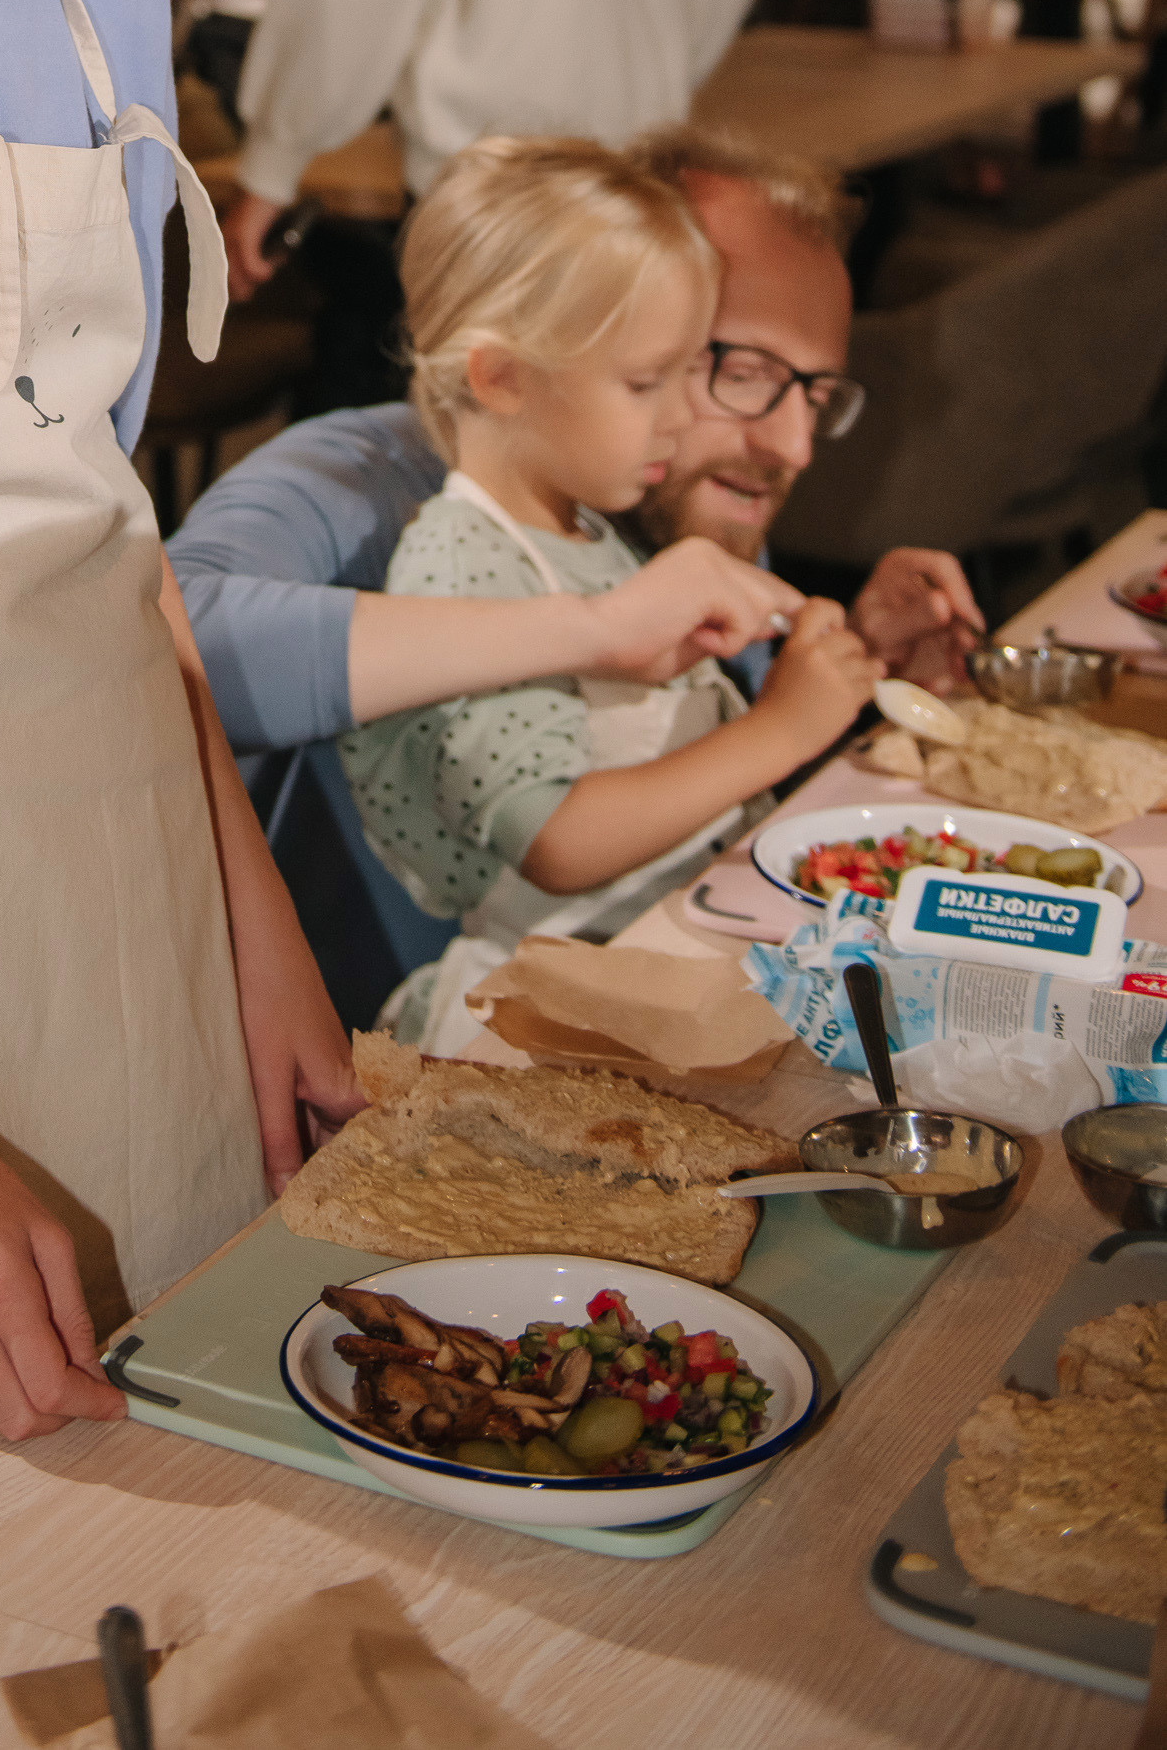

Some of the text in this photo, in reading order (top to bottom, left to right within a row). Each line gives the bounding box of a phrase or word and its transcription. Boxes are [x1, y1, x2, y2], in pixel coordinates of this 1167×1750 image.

[938, 887, 1081, 924] САЛФЕТКИ
[937, 906, 1075, 937] АНТИБАКТЕРИАЛЬНЫЕ
[970, 923, 1035, 943] ВЛАЖНЫЕ
